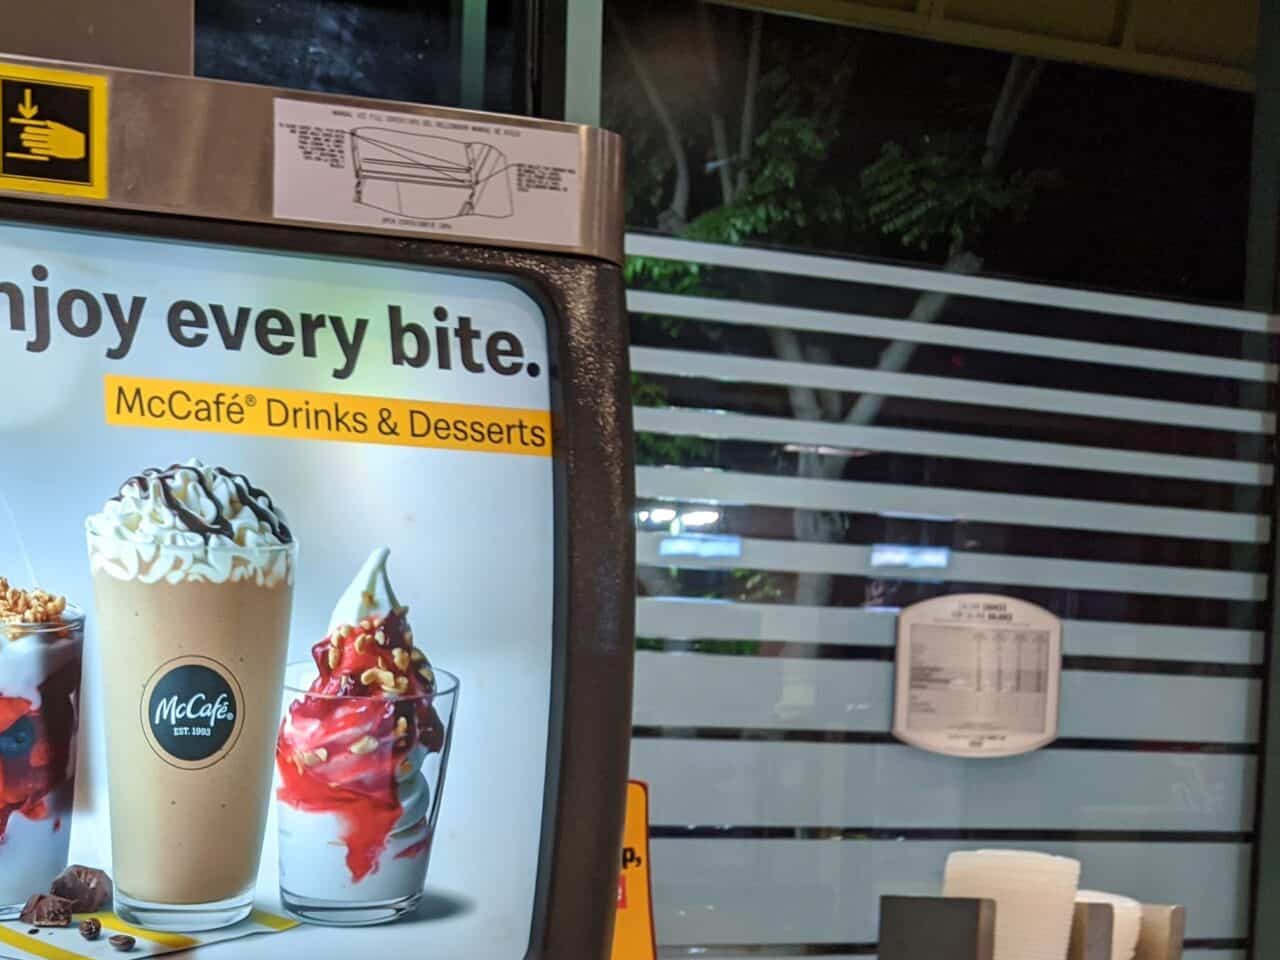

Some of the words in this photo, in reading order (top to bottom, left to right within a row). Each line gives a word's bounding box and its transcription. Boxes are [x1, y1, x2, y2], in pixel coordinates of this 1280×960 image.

[166, 298, 369, 379] every
[388, 304, 541, 378] bite.
[266, 398, 368, 433] Drinks
[377, 407, 401, 437] &
[409, 409, 546, 447] Desserts
[173, 727, 190, 736] EST.
